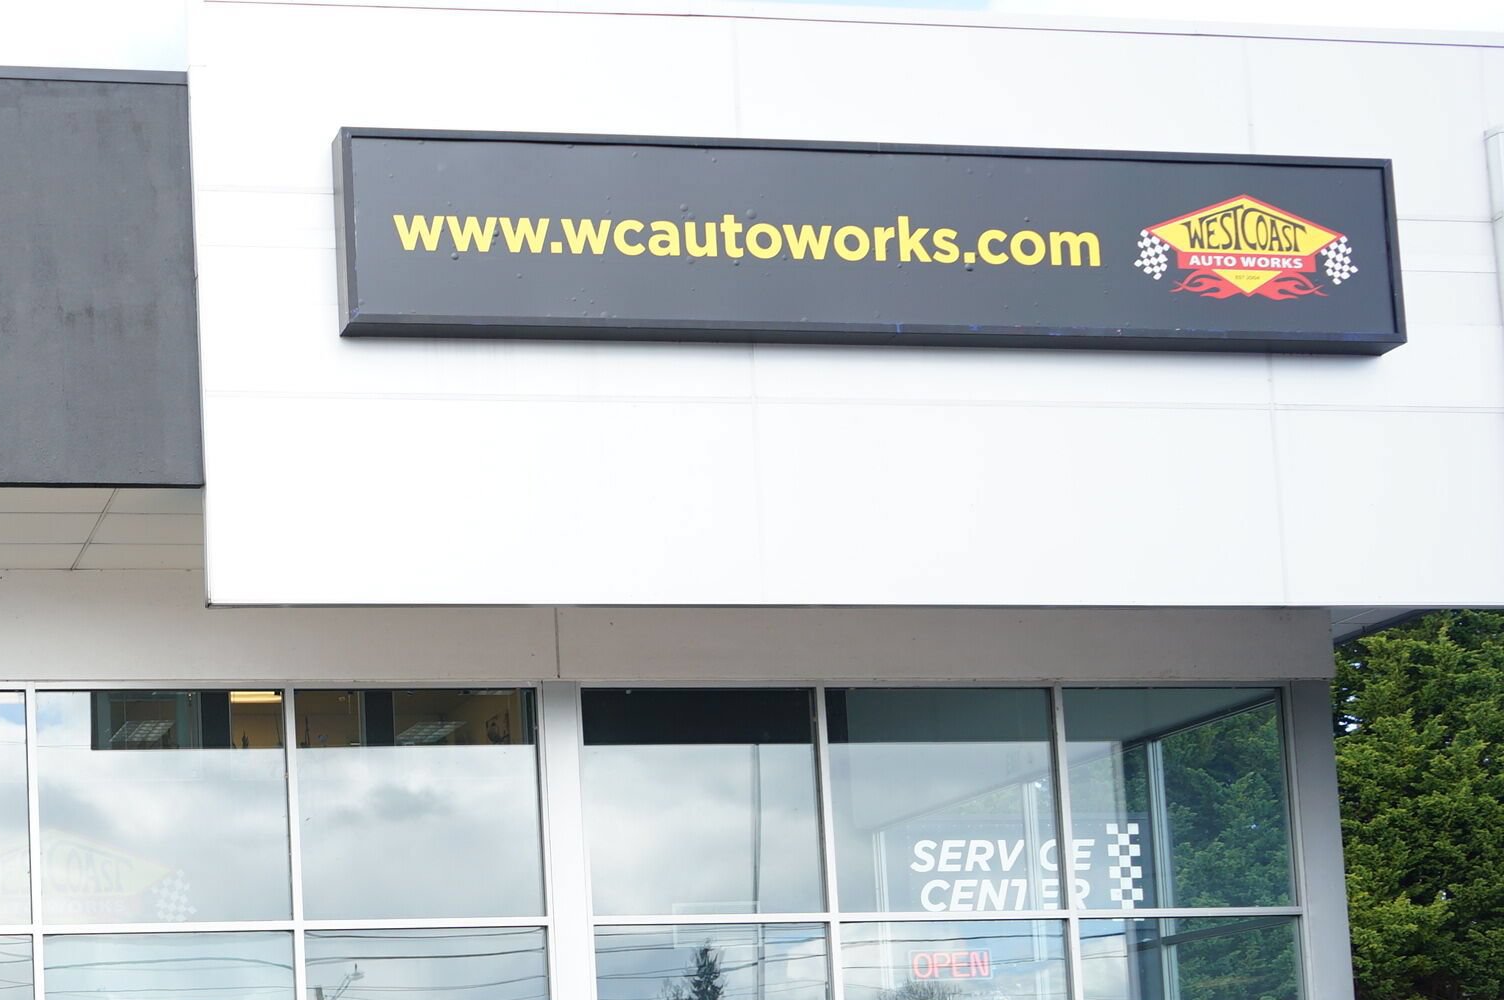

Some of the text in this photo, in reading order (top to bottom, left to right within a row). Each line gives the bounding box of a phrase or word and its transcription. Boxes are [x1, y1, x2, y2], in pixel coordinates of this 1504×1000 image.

[393, 212, 1103, 268] www.wcautoworks.com
[1188, 255, 1304, 269] AUTO WORKS
[910, 839, 1096, 872] SERVCE
[912, 950, 990, 979] OPEN
